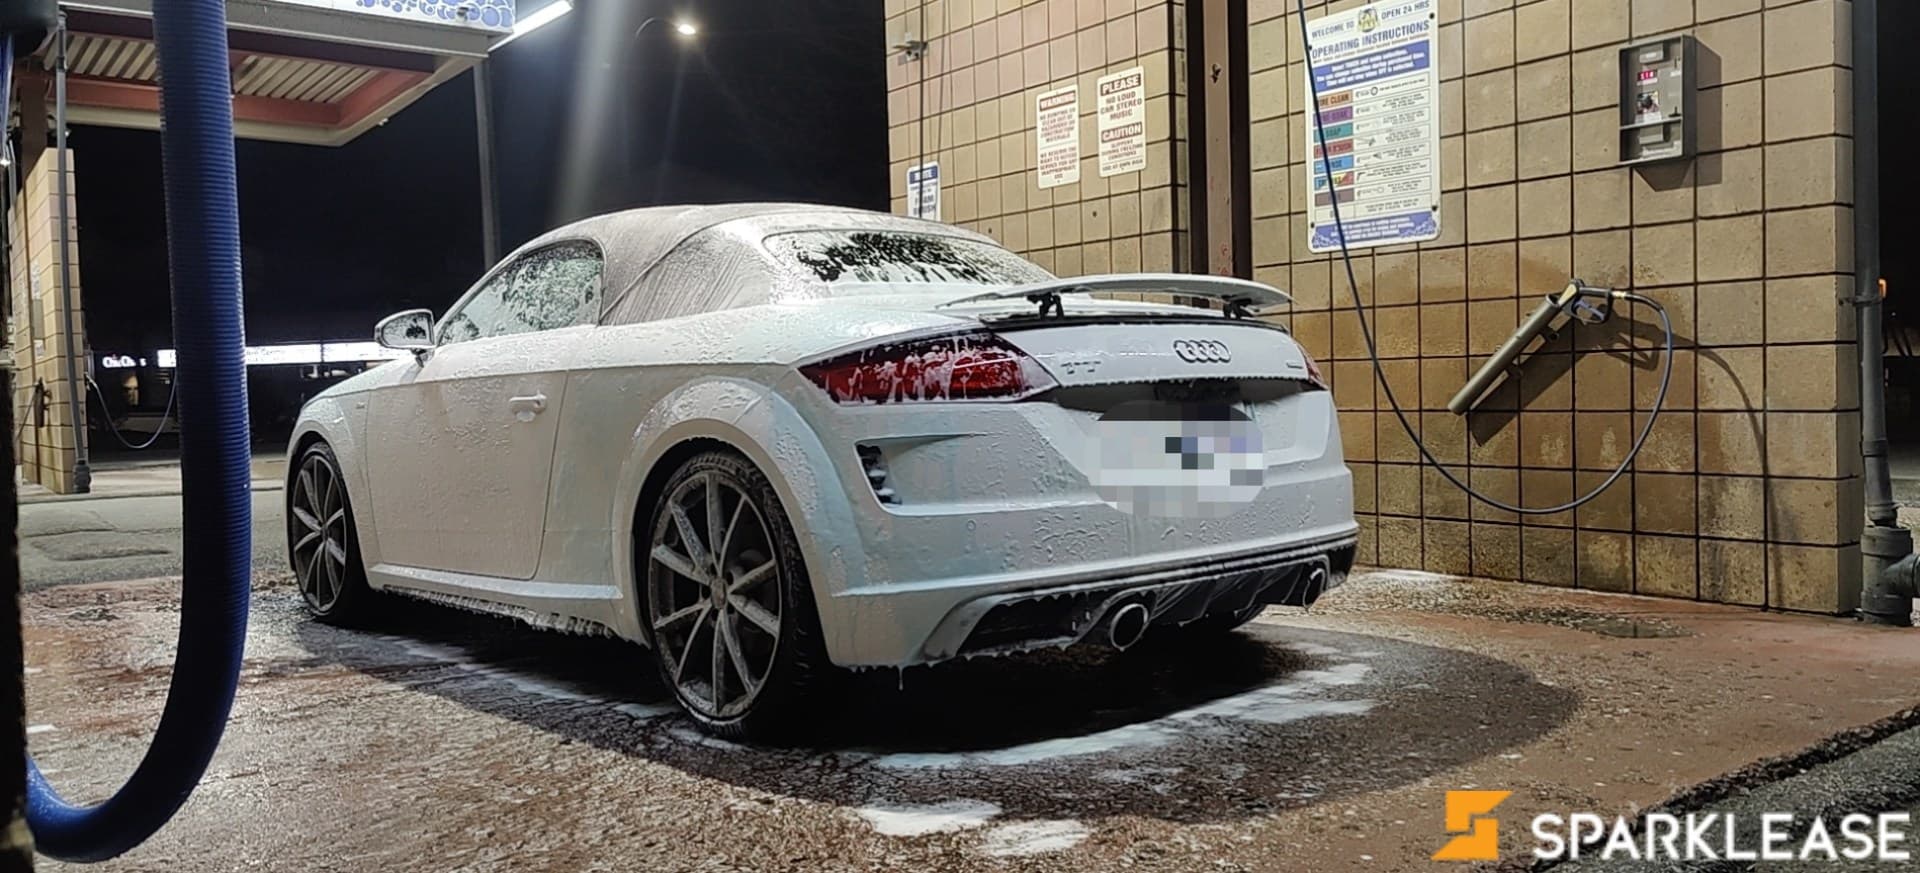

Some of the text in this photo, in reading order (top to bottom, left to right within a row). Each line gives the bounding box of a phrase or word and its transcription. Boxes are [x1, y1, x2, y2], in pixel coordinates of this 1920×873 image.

[1381, 1, 1430, 20] OPEN 24 HRS
[1311, 21, 1355, 39] WELCOME TO
[1311, 37, 1360, 59] OPERATING
[1362, 20, 1430, 45] INSTRUCTIONS
[1101, 74, 1139, 95] PLEASE
[1100, 98, 1143, 115] CAR STEREO
[1105, 91, 1136, 104] NO LOUD
[1330, 93, 1349, 105] CLEAN
[1109, 110, 1133, 121] MUSIC
[1102, 124, 1142, 142] CAUTION
